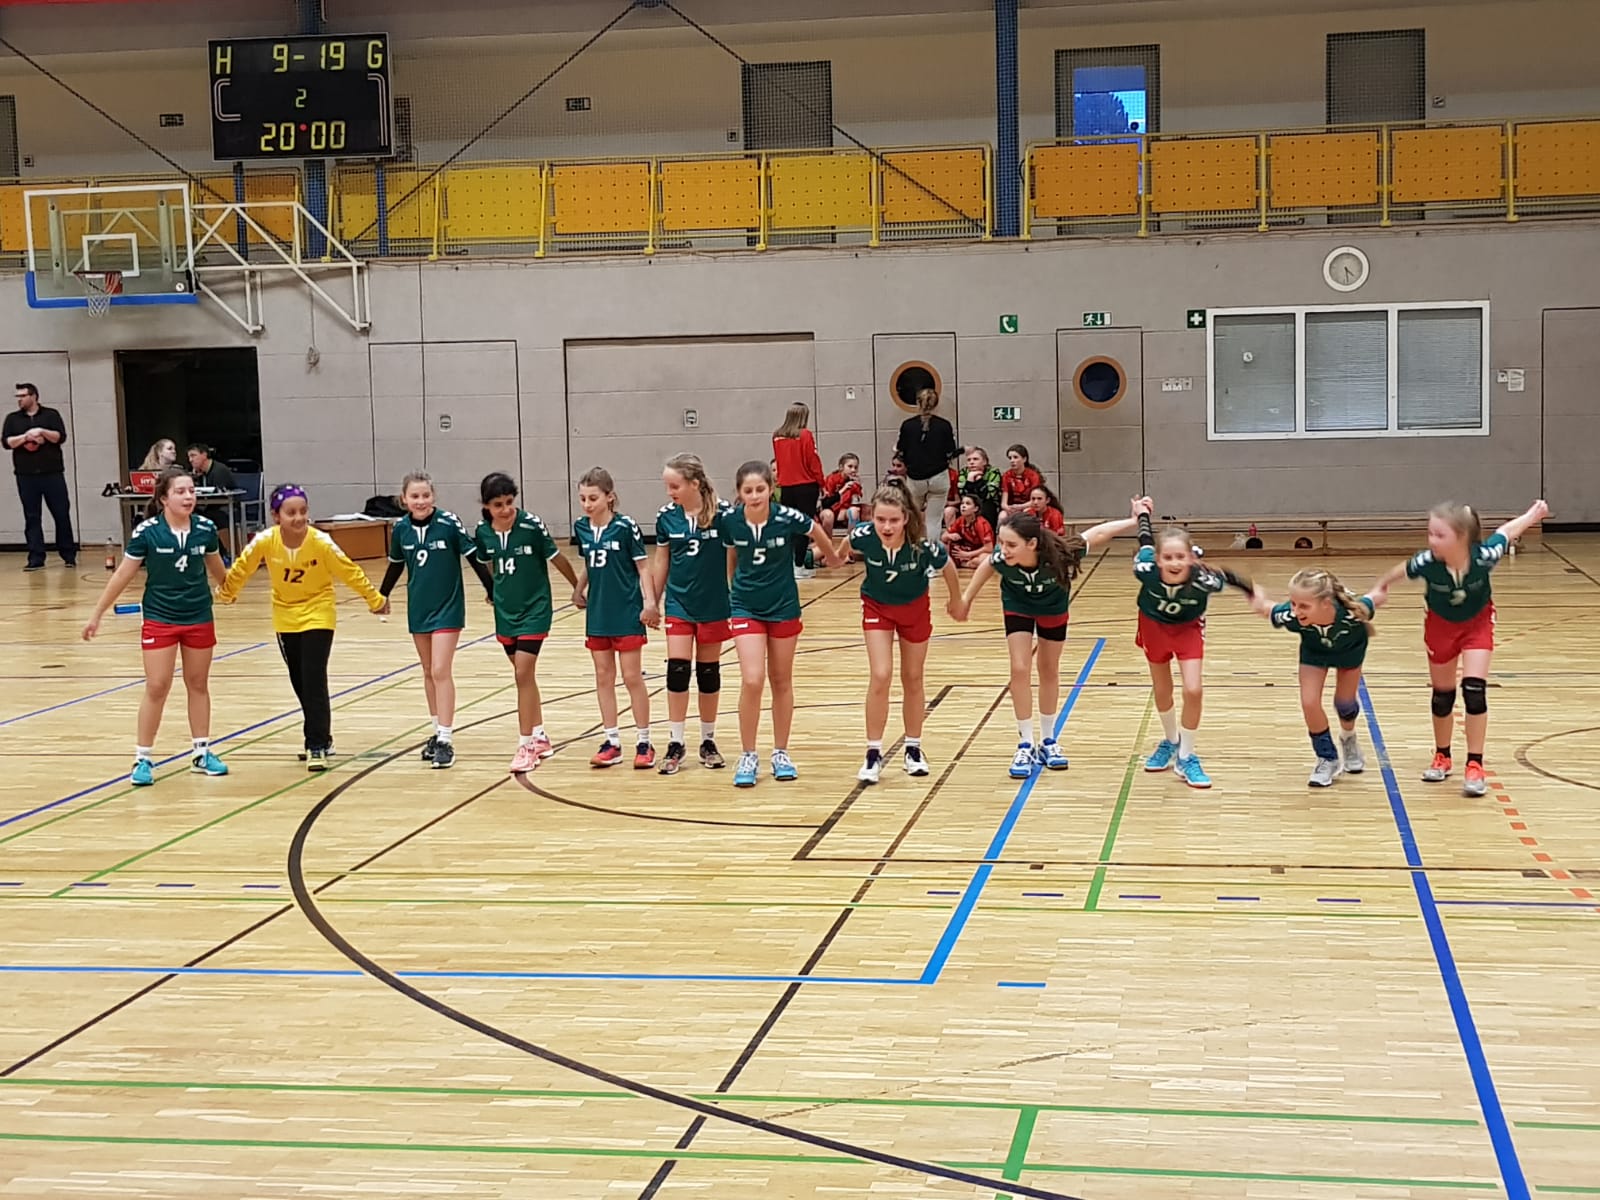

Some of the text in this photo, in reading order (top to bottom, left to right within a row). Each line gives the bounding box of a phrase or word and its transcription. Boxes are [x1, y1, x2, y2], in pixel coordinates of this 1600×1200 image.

[216, 46, 232, 75] H
[367, 40, 383, 69] G
[295, 88, 307, 108] 2
[686, 539, 700, 556] 3
[174, 554, 188, 572] 4
[416, 549, 428, 567] 9
[589, 549, 607, 568] 13
[752, 548, 766, 565] 5
[498, 558, 516, 574] 14
[283, 567, 305, 584] 12
[885, 570, 898, 583] 7
[1157, 600, 1181, 615] 10
